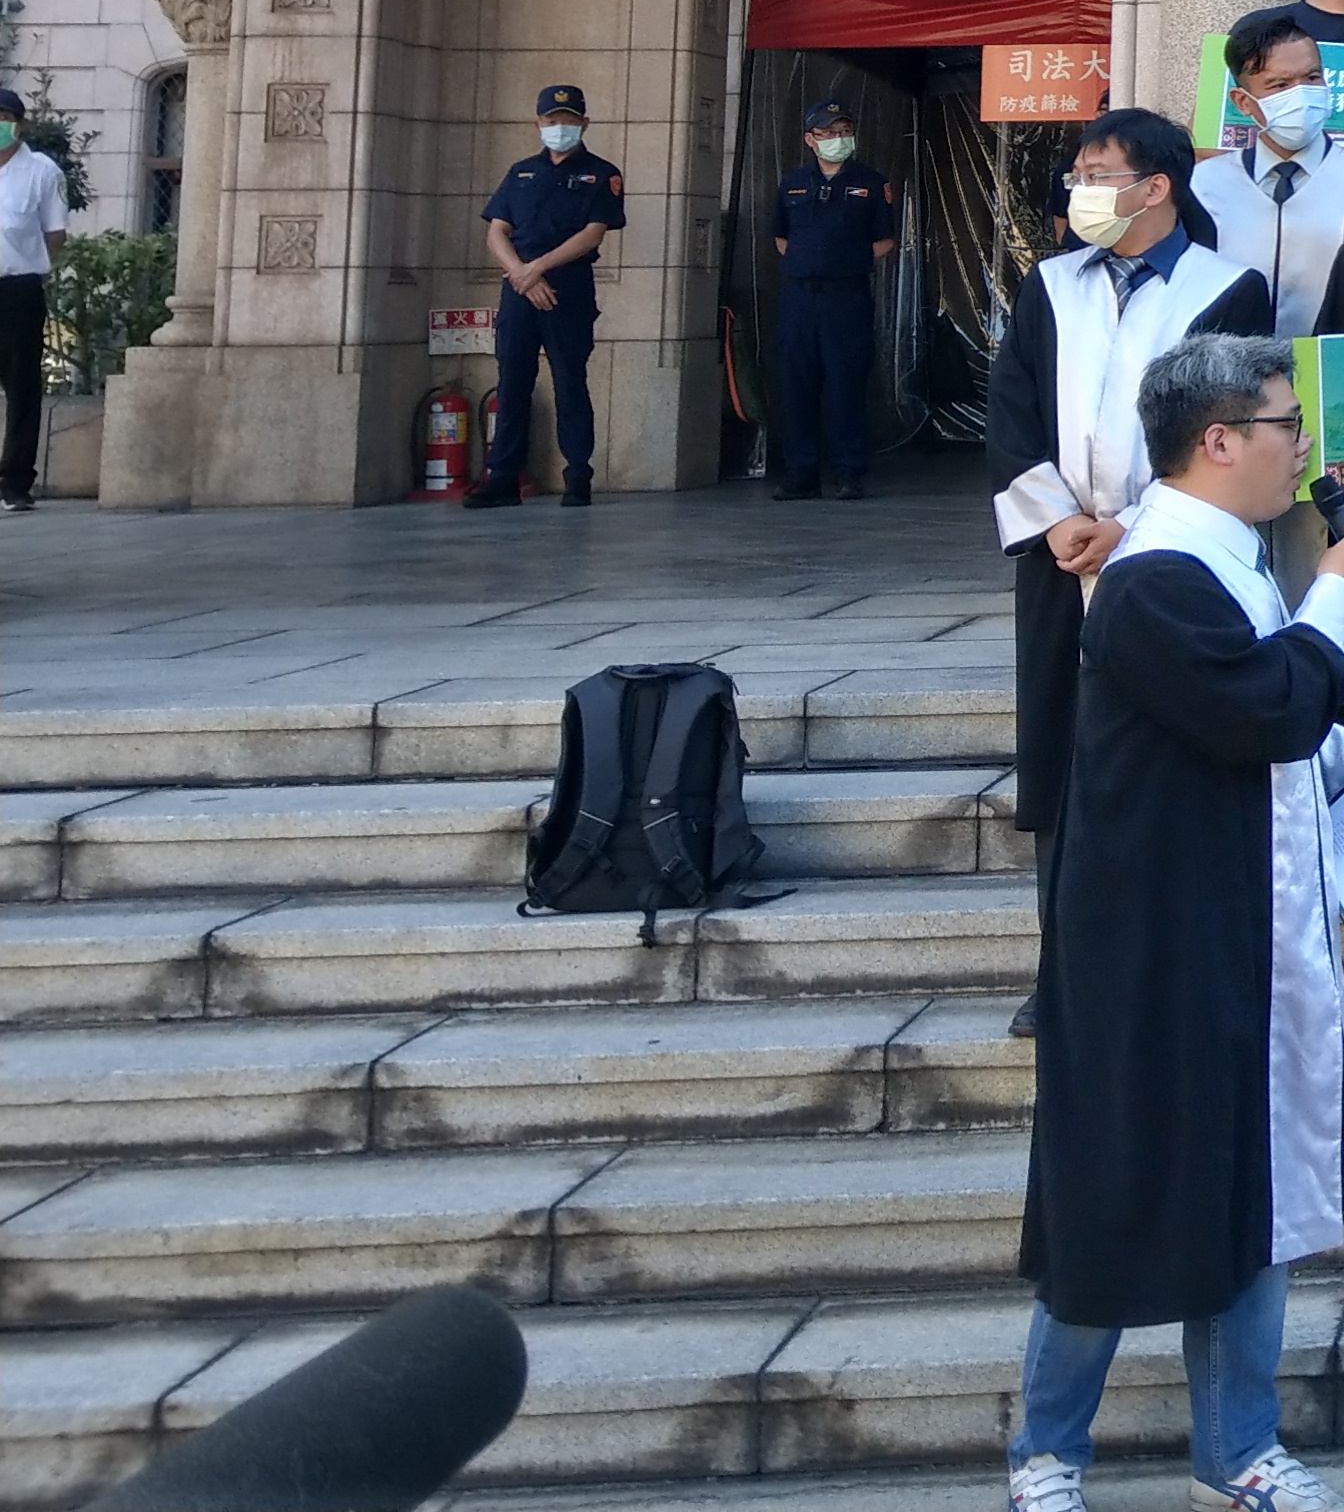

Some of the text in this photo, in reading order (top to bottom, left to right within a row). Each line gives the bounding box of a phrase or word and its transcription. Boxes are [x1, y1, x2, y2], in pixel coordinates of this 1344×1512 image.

[1008, 49, 1110, 83] 司法大
[999, 93, 1080, 114] 防疫篩檢
